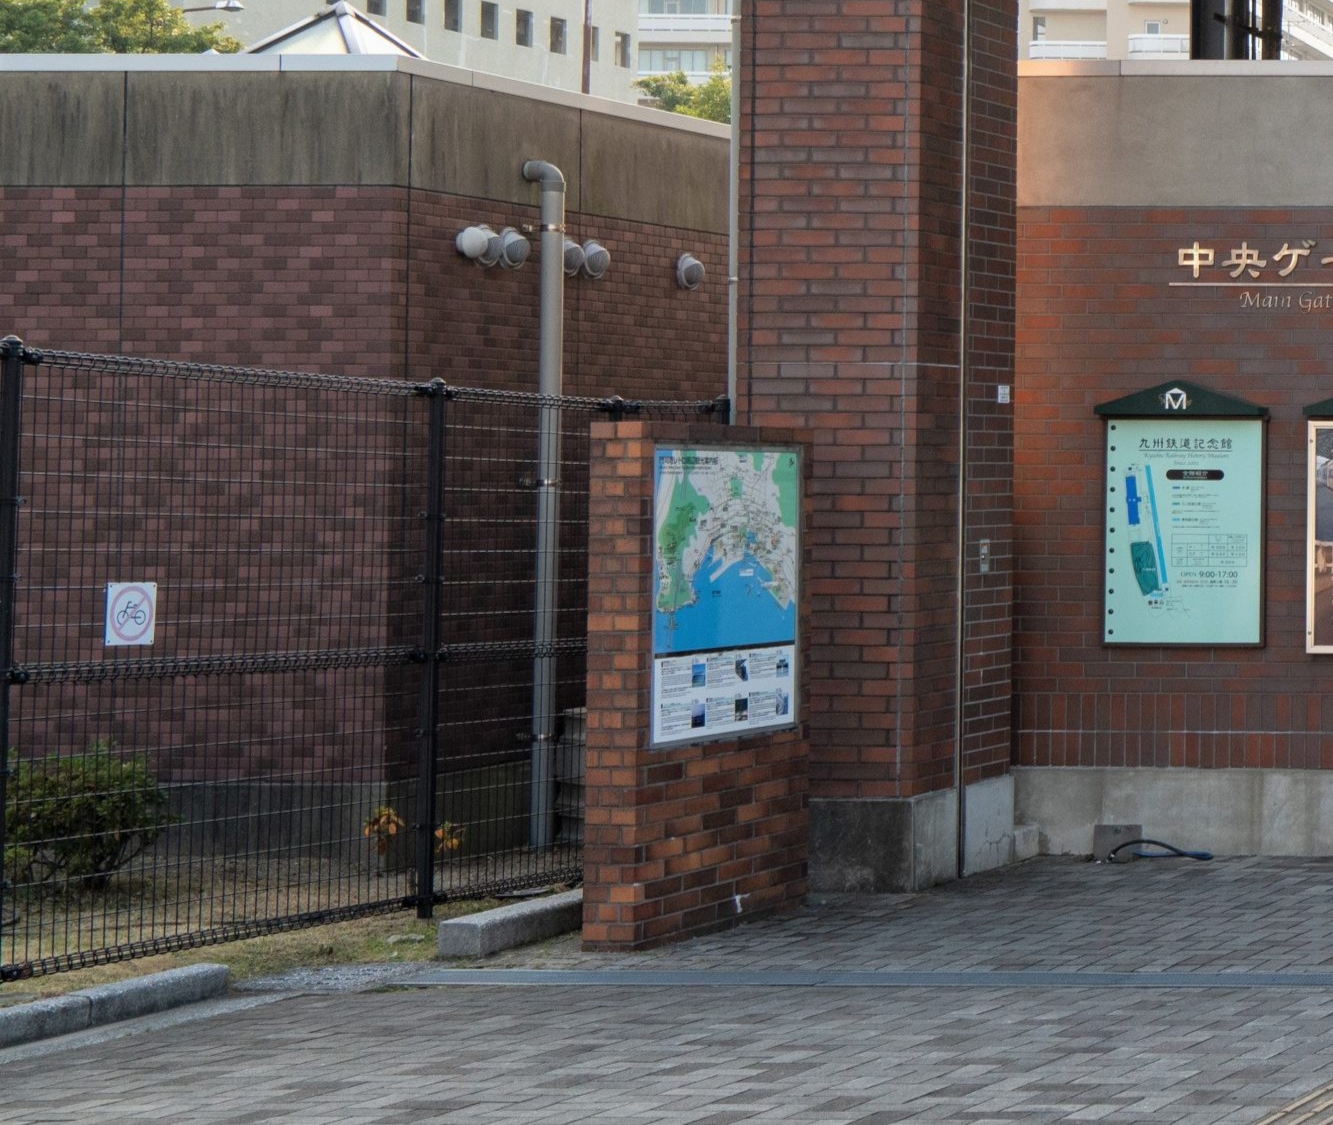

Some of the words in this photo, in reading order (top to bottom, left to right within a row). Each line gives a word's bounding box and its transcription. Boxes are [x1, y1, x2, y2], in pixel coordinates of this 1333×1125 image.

[1239, 291, 1291, 310] Main
[1139, 437, 1233, 450] 九州鉄道記念館
